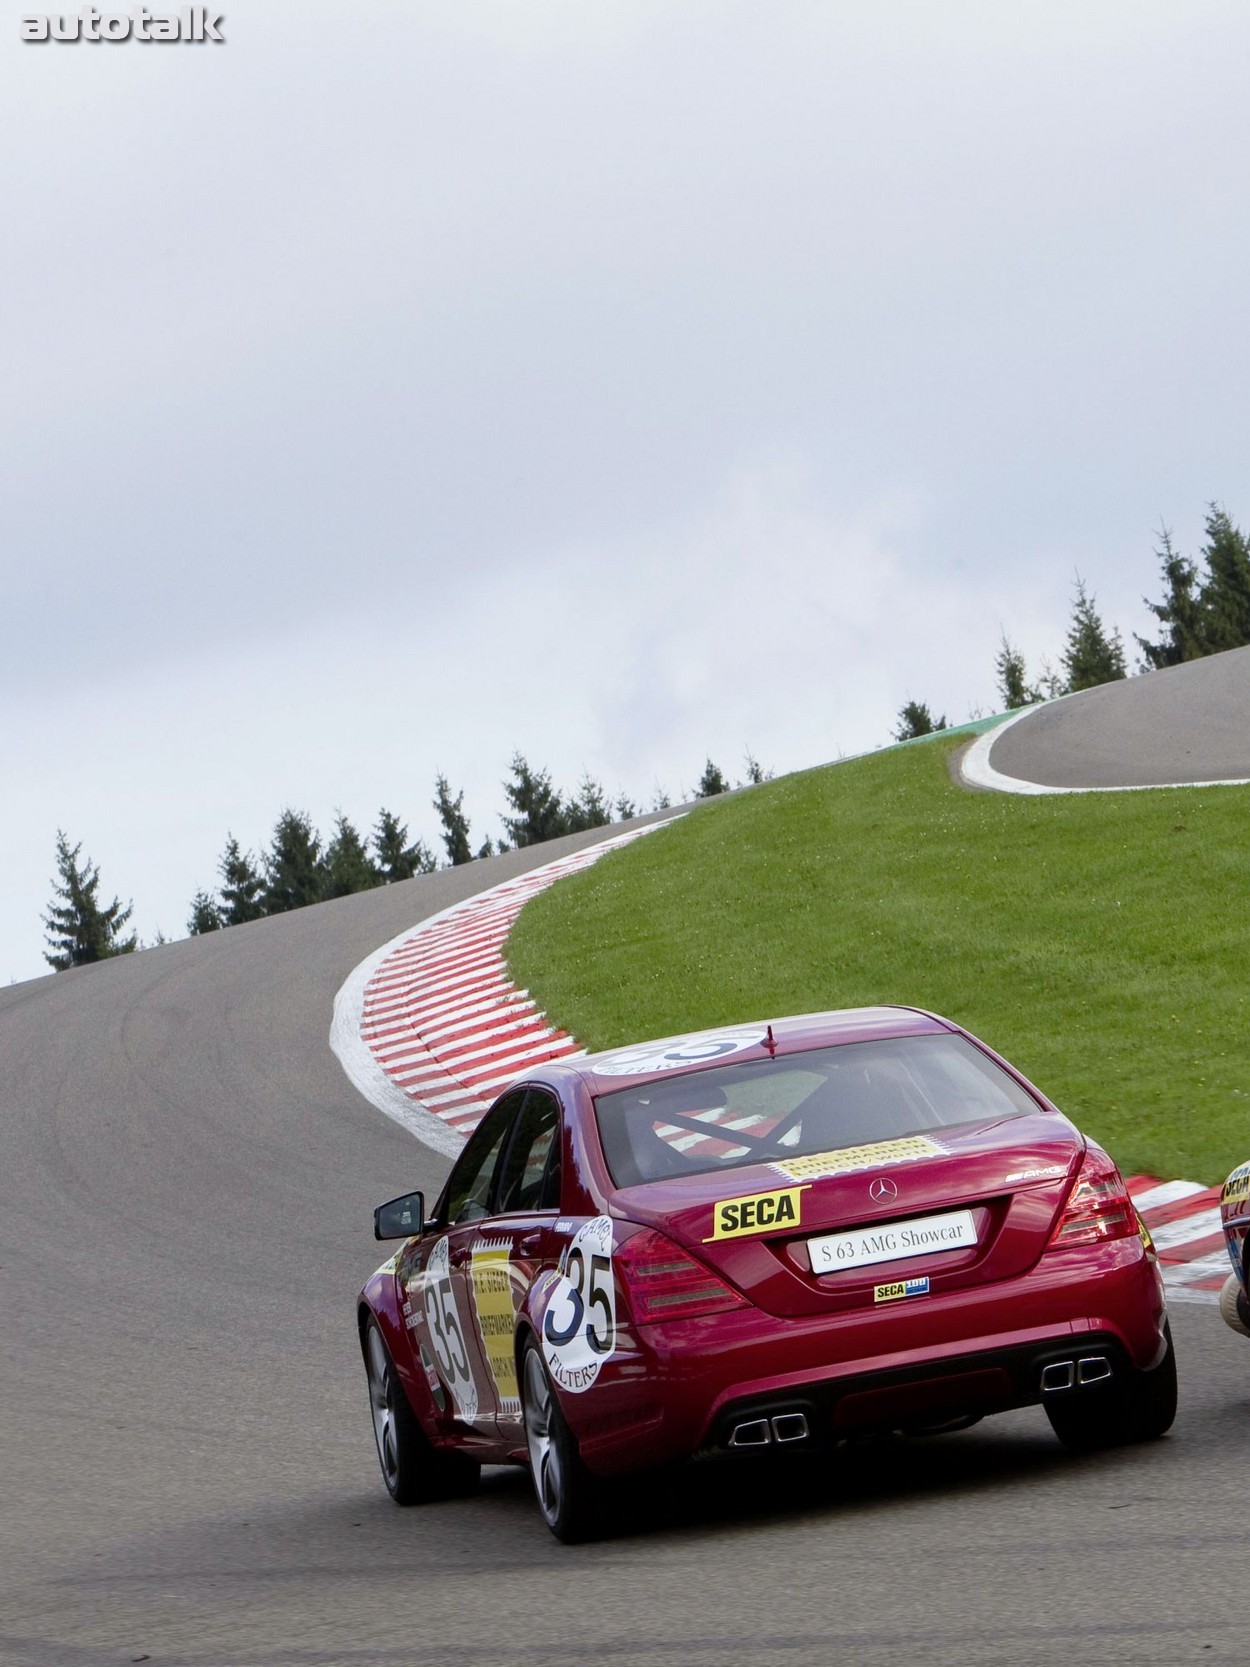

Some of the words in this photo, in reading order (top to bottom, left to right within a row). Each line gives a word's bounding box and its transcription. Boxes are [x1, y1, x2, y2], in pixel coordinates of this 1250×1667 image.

[721, 1195, 795, 1232] SECA
[821, 1245, 832, 1262] S
[836, 1241, 855, 1260] 63
[861, 1233, 897, 1256] AMG
[902, 1225, 963, 1248] Showcar
[544, 1247, 614, 1354] 35
[877, 1284, 904, 1297] SECA
[425, 1278, 470, 1384] 35
[549, 1353, 597, 1387] FILTERS
